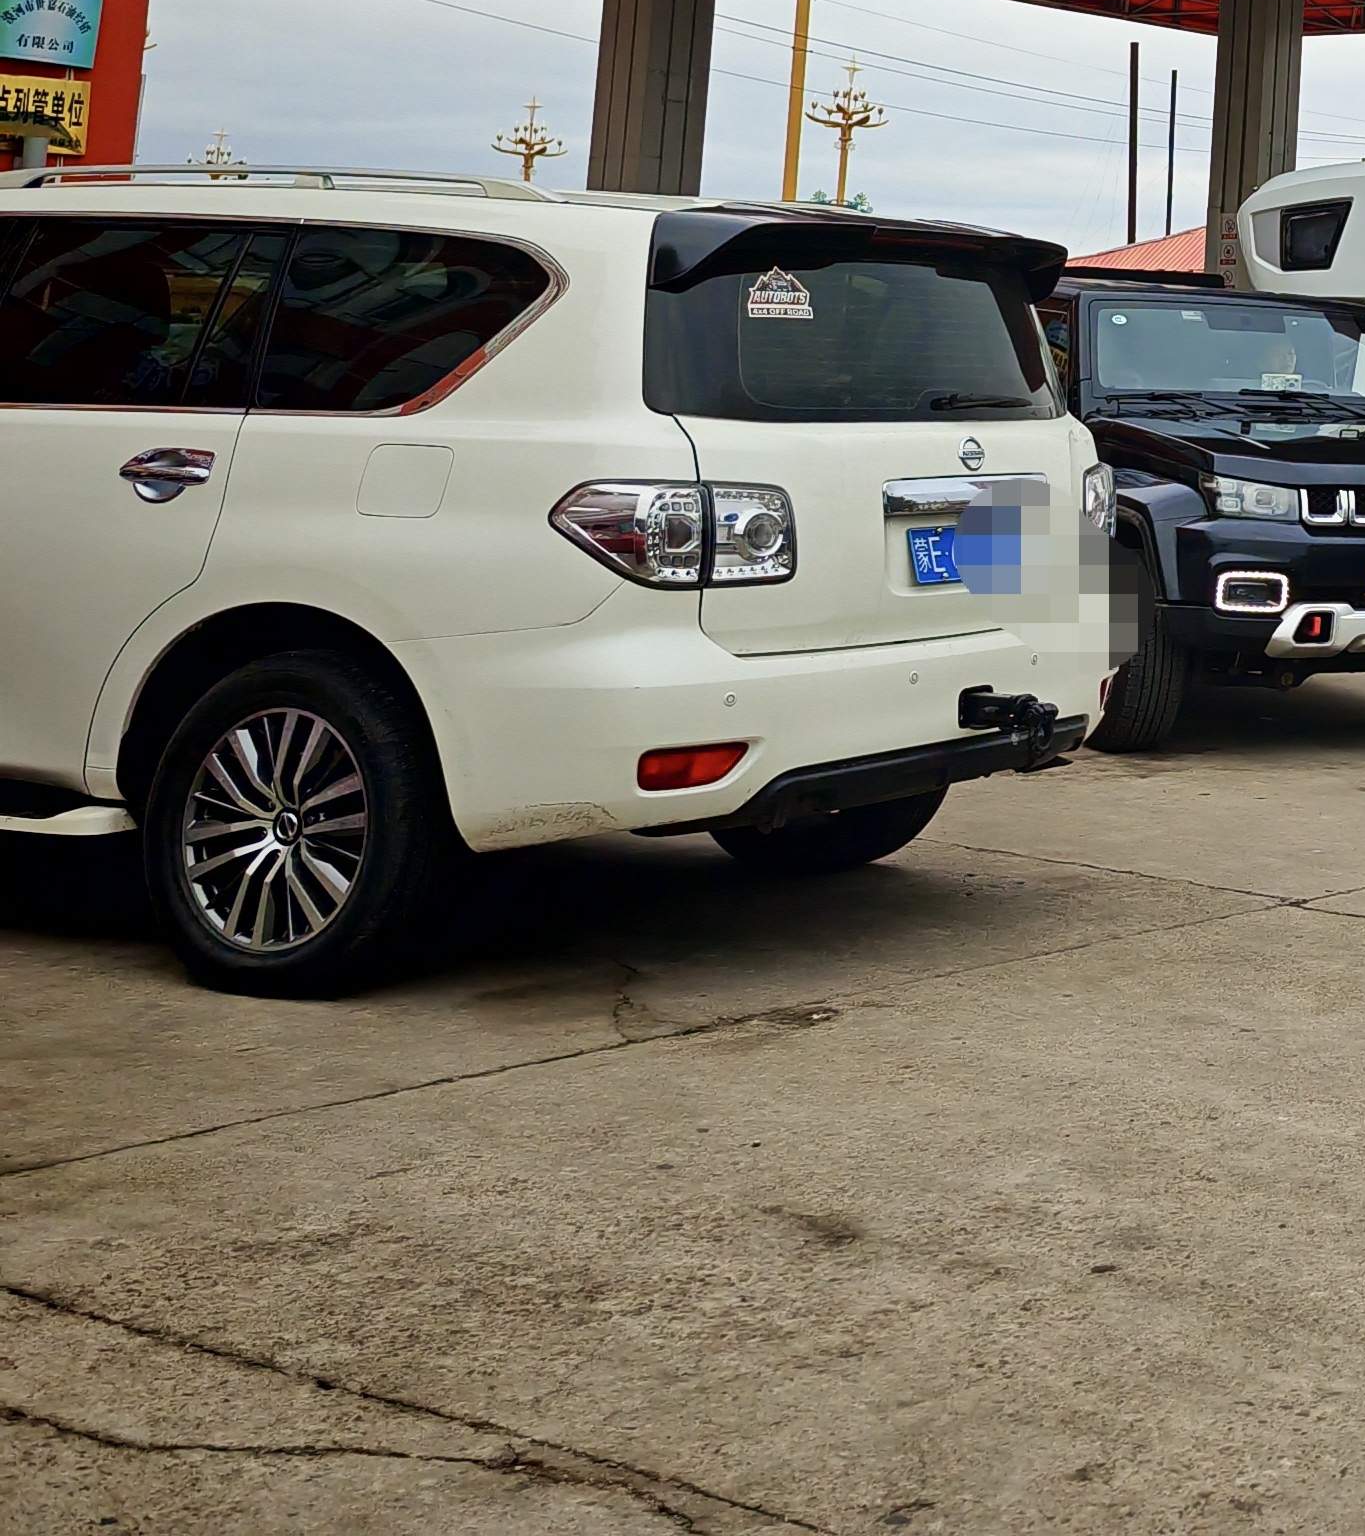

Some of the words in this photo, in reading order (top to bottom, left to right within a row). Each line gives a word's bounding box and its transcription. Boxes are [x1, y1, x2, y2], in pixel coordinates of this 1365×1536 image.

[16, 33, 75, 54] 有限公司
[752, 290, 806, 304] AUTOBOTS
